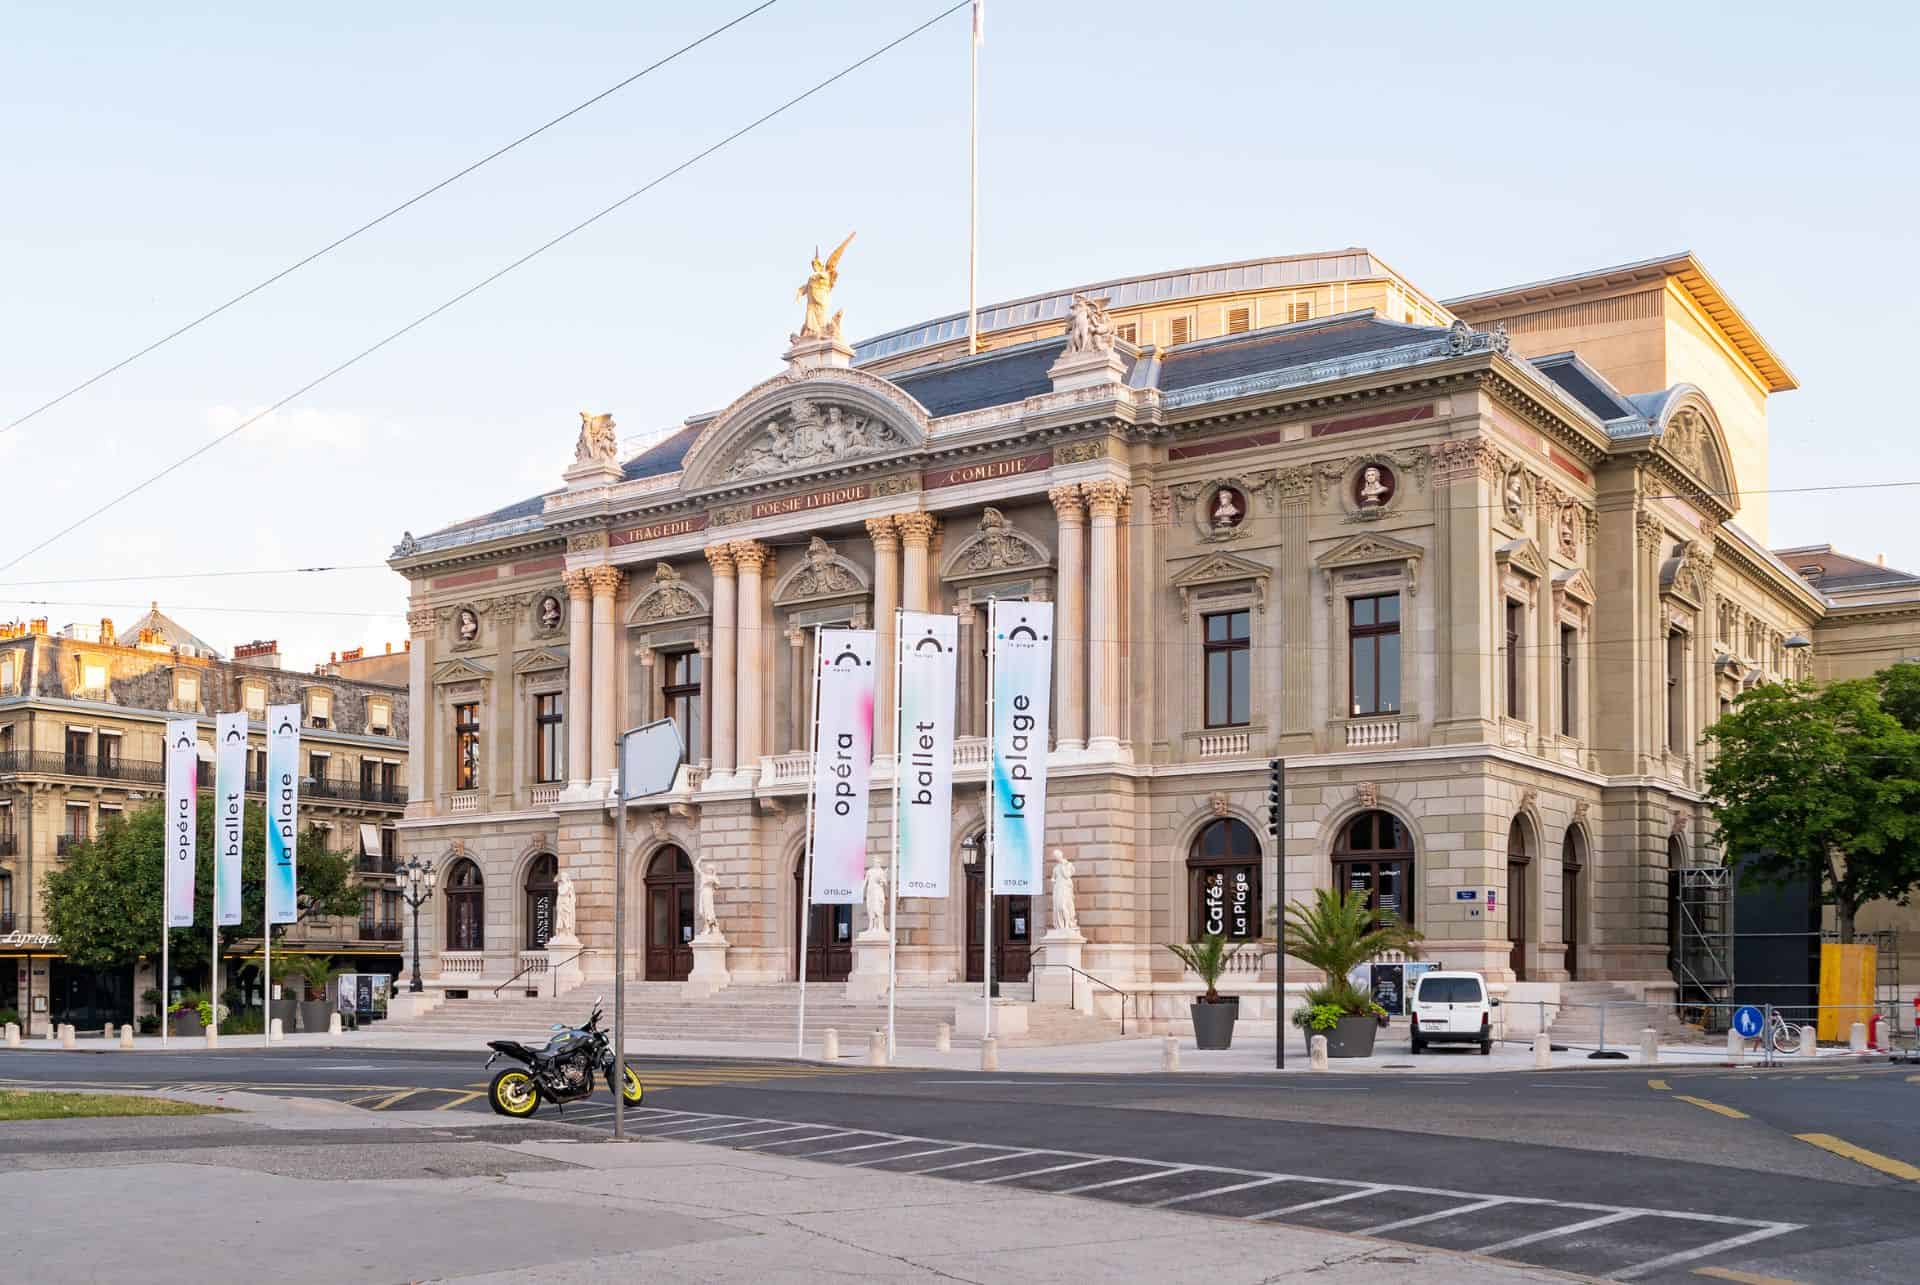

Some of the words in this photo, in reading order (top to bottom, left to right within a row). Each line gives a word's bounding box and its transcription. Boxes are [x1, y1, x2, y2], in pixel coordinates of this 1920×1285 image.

[950, 458, 1026, 483] COMEDIE
[756, 497, 801, 517] POESIE
[806, 486, 865, 508] LYRIQUE
[629, 521, 690, 542] TRAGEDIE
[912, 721, 935, 805] ballet
[1005, 694, 1036, 781] plage
[830, 732, 857, 816] opéra
[176, 798, 190, 861] opéra
[225, 792, 239, 857] ballet
[277, 773, 294, 838] plage
[1004, 793, 1025, 819] la
[277, 847, 292, 867] la
[1206, 886, 1223, 935] Café
[1216, 873, 1223, 886] de
[1233, 873, 1249, 914] Plage
[1233, 918, 1246, 935] La
